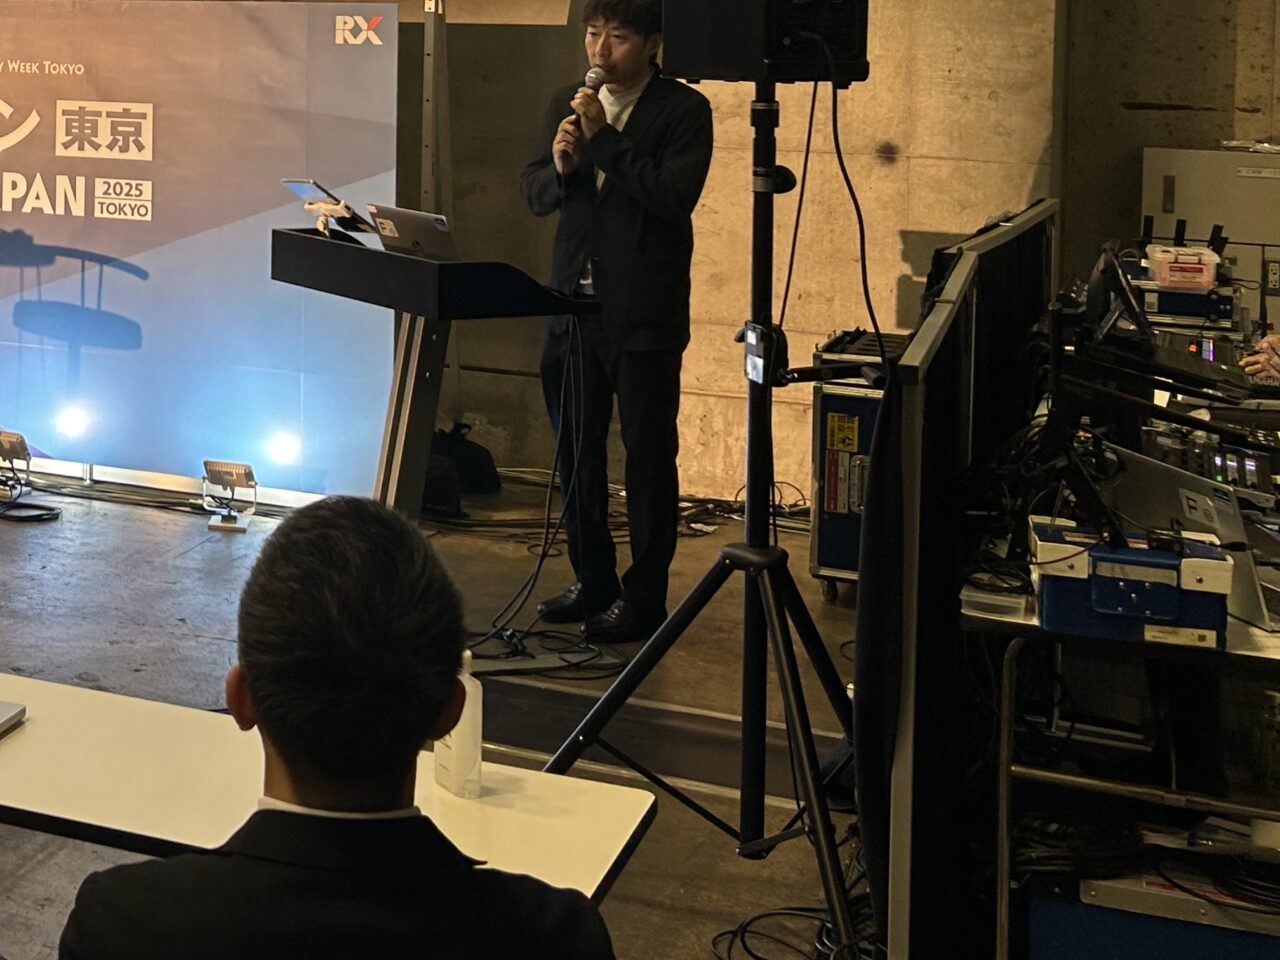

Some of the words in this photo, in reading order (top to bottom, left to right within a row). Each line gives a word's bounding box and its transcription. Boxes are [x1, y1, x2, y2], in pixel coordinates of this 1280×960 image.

[335, 15, 384, 45] RX
[60, 104, 150, 155] 東京
[102, 181, 144, 198] 2025
[97, 201, 150, 218] TOKYO
